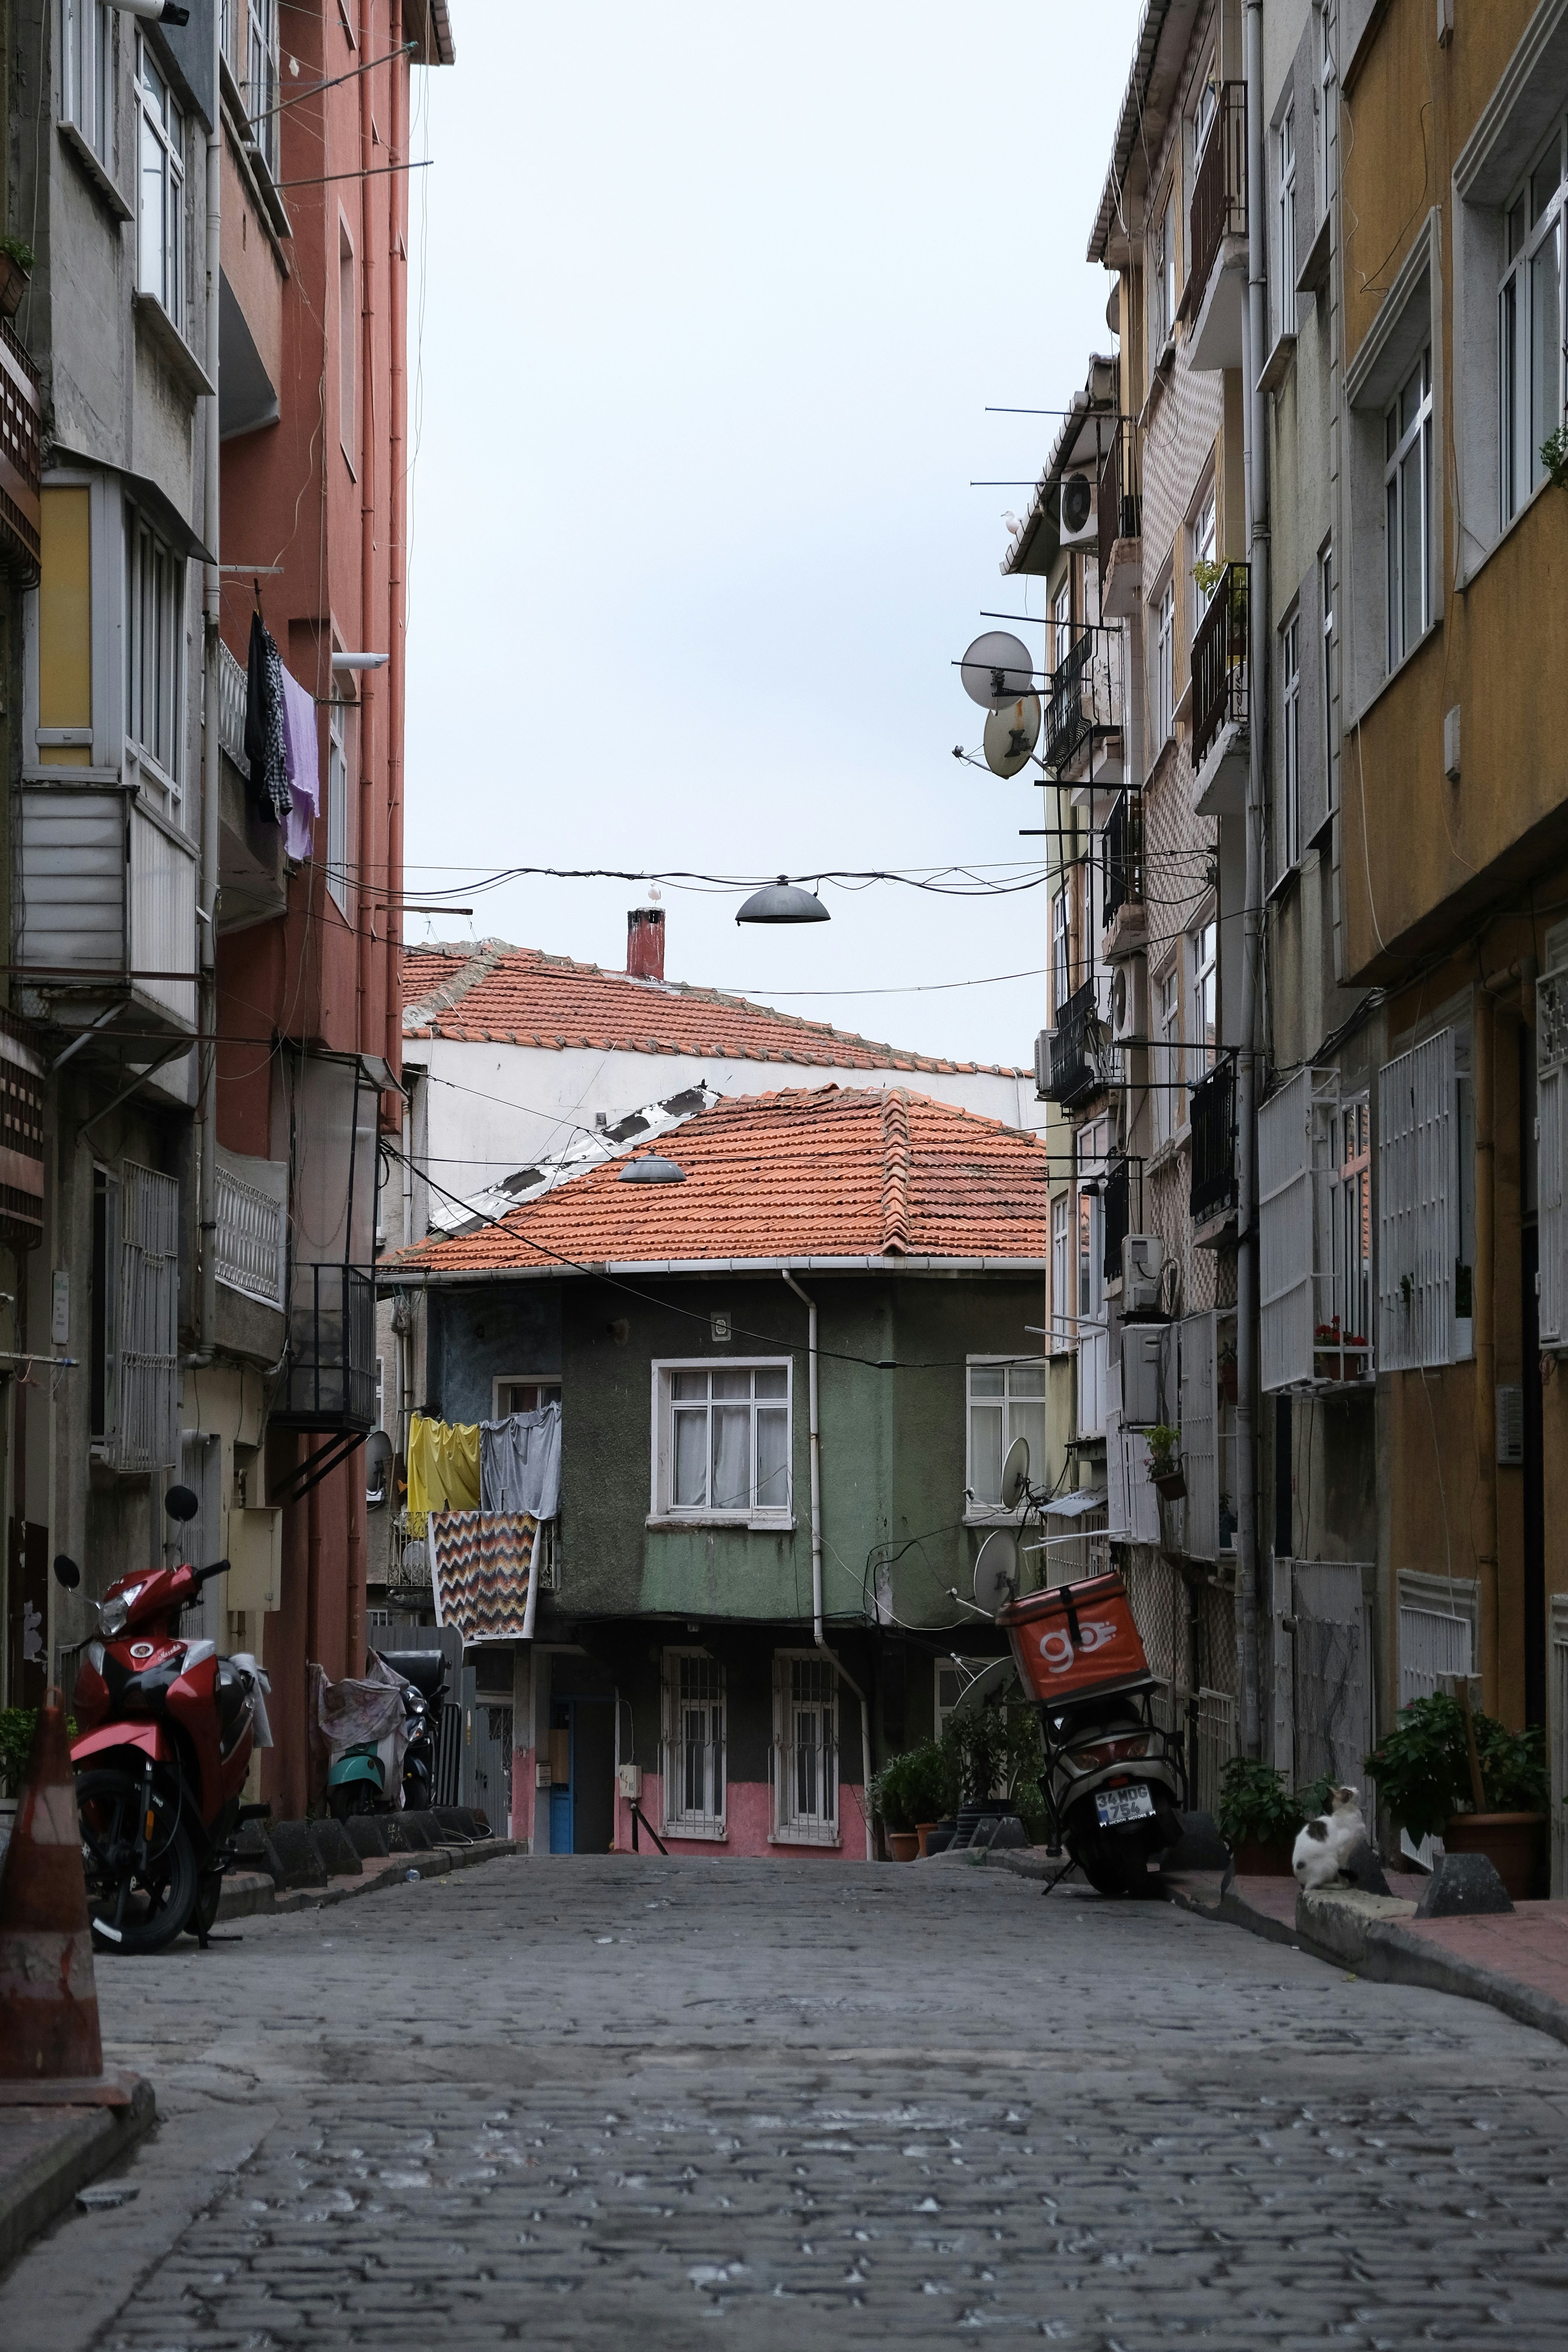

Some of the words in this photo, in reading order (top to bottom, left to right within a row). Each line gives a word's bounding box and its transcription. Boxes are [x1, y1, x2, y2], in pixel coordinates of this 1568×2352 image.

[1098, 1793, 1117, 1808] 34
[1118, 1787, 1148, 1803] MDG
[1110, 1802, 1141, 1819] 754
